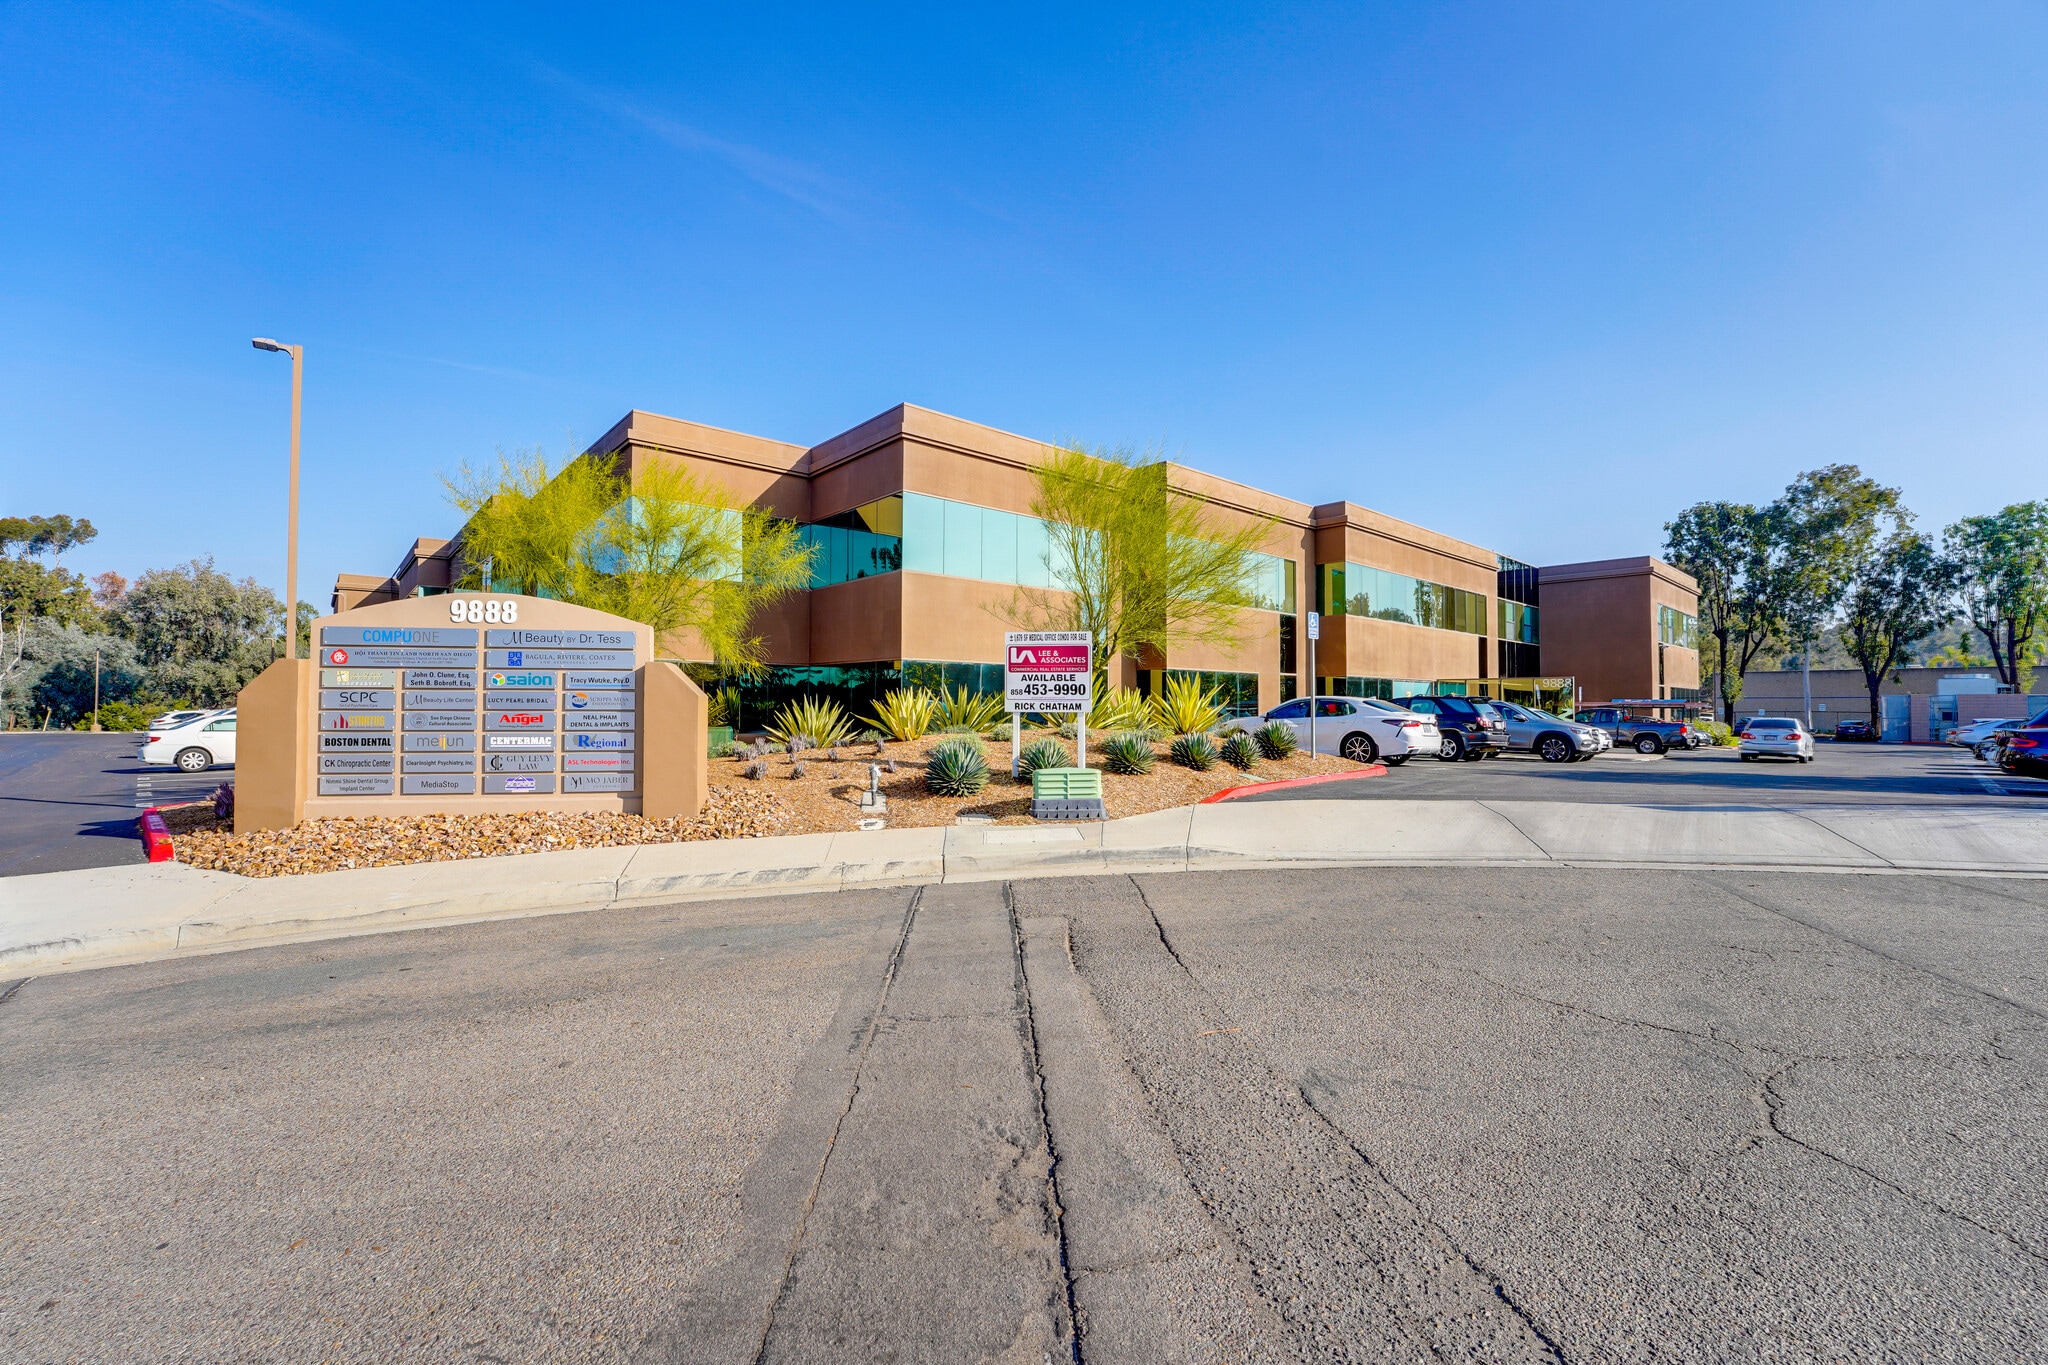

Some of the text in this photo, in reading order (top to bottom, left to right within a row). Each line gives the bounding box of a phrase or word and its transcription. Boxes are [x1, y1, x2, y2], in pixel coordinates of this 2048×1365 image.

[450, 599, 517, 624] 9888
[362, 630, 440, 643] COMPUONE
[525, 633, 564, 645] Beauty
[580, 634, 594, 644] Dr.
[598, 634, 621, 644] Tess
[1029, 633, 1043, 641] MEDICAL
[1045, 633, 1056, 641] OFFICE
[1057, 633, 1069, 641] CONDO
[506, 672, 552, 686] saion
[1021, 674, 1076, 682] AVAILABLE
[1542, 679, 1572, 688] 9888
[1024, 684, 1086, 695] 453-9990
[340, 692, 378, 703] SCPC
[349, 715, 385, 726] STRATUS
[500, 714, 543, 725] Angel
[325, 738, 391, 746] BOSTON DENTAL
[490, 737, 552, 745] CENTERMAC
[578, 735, 626, 748] Regional
[337, 760, 371, 768] Chiropractic
[421, 781, 459, 789] MediaStop
